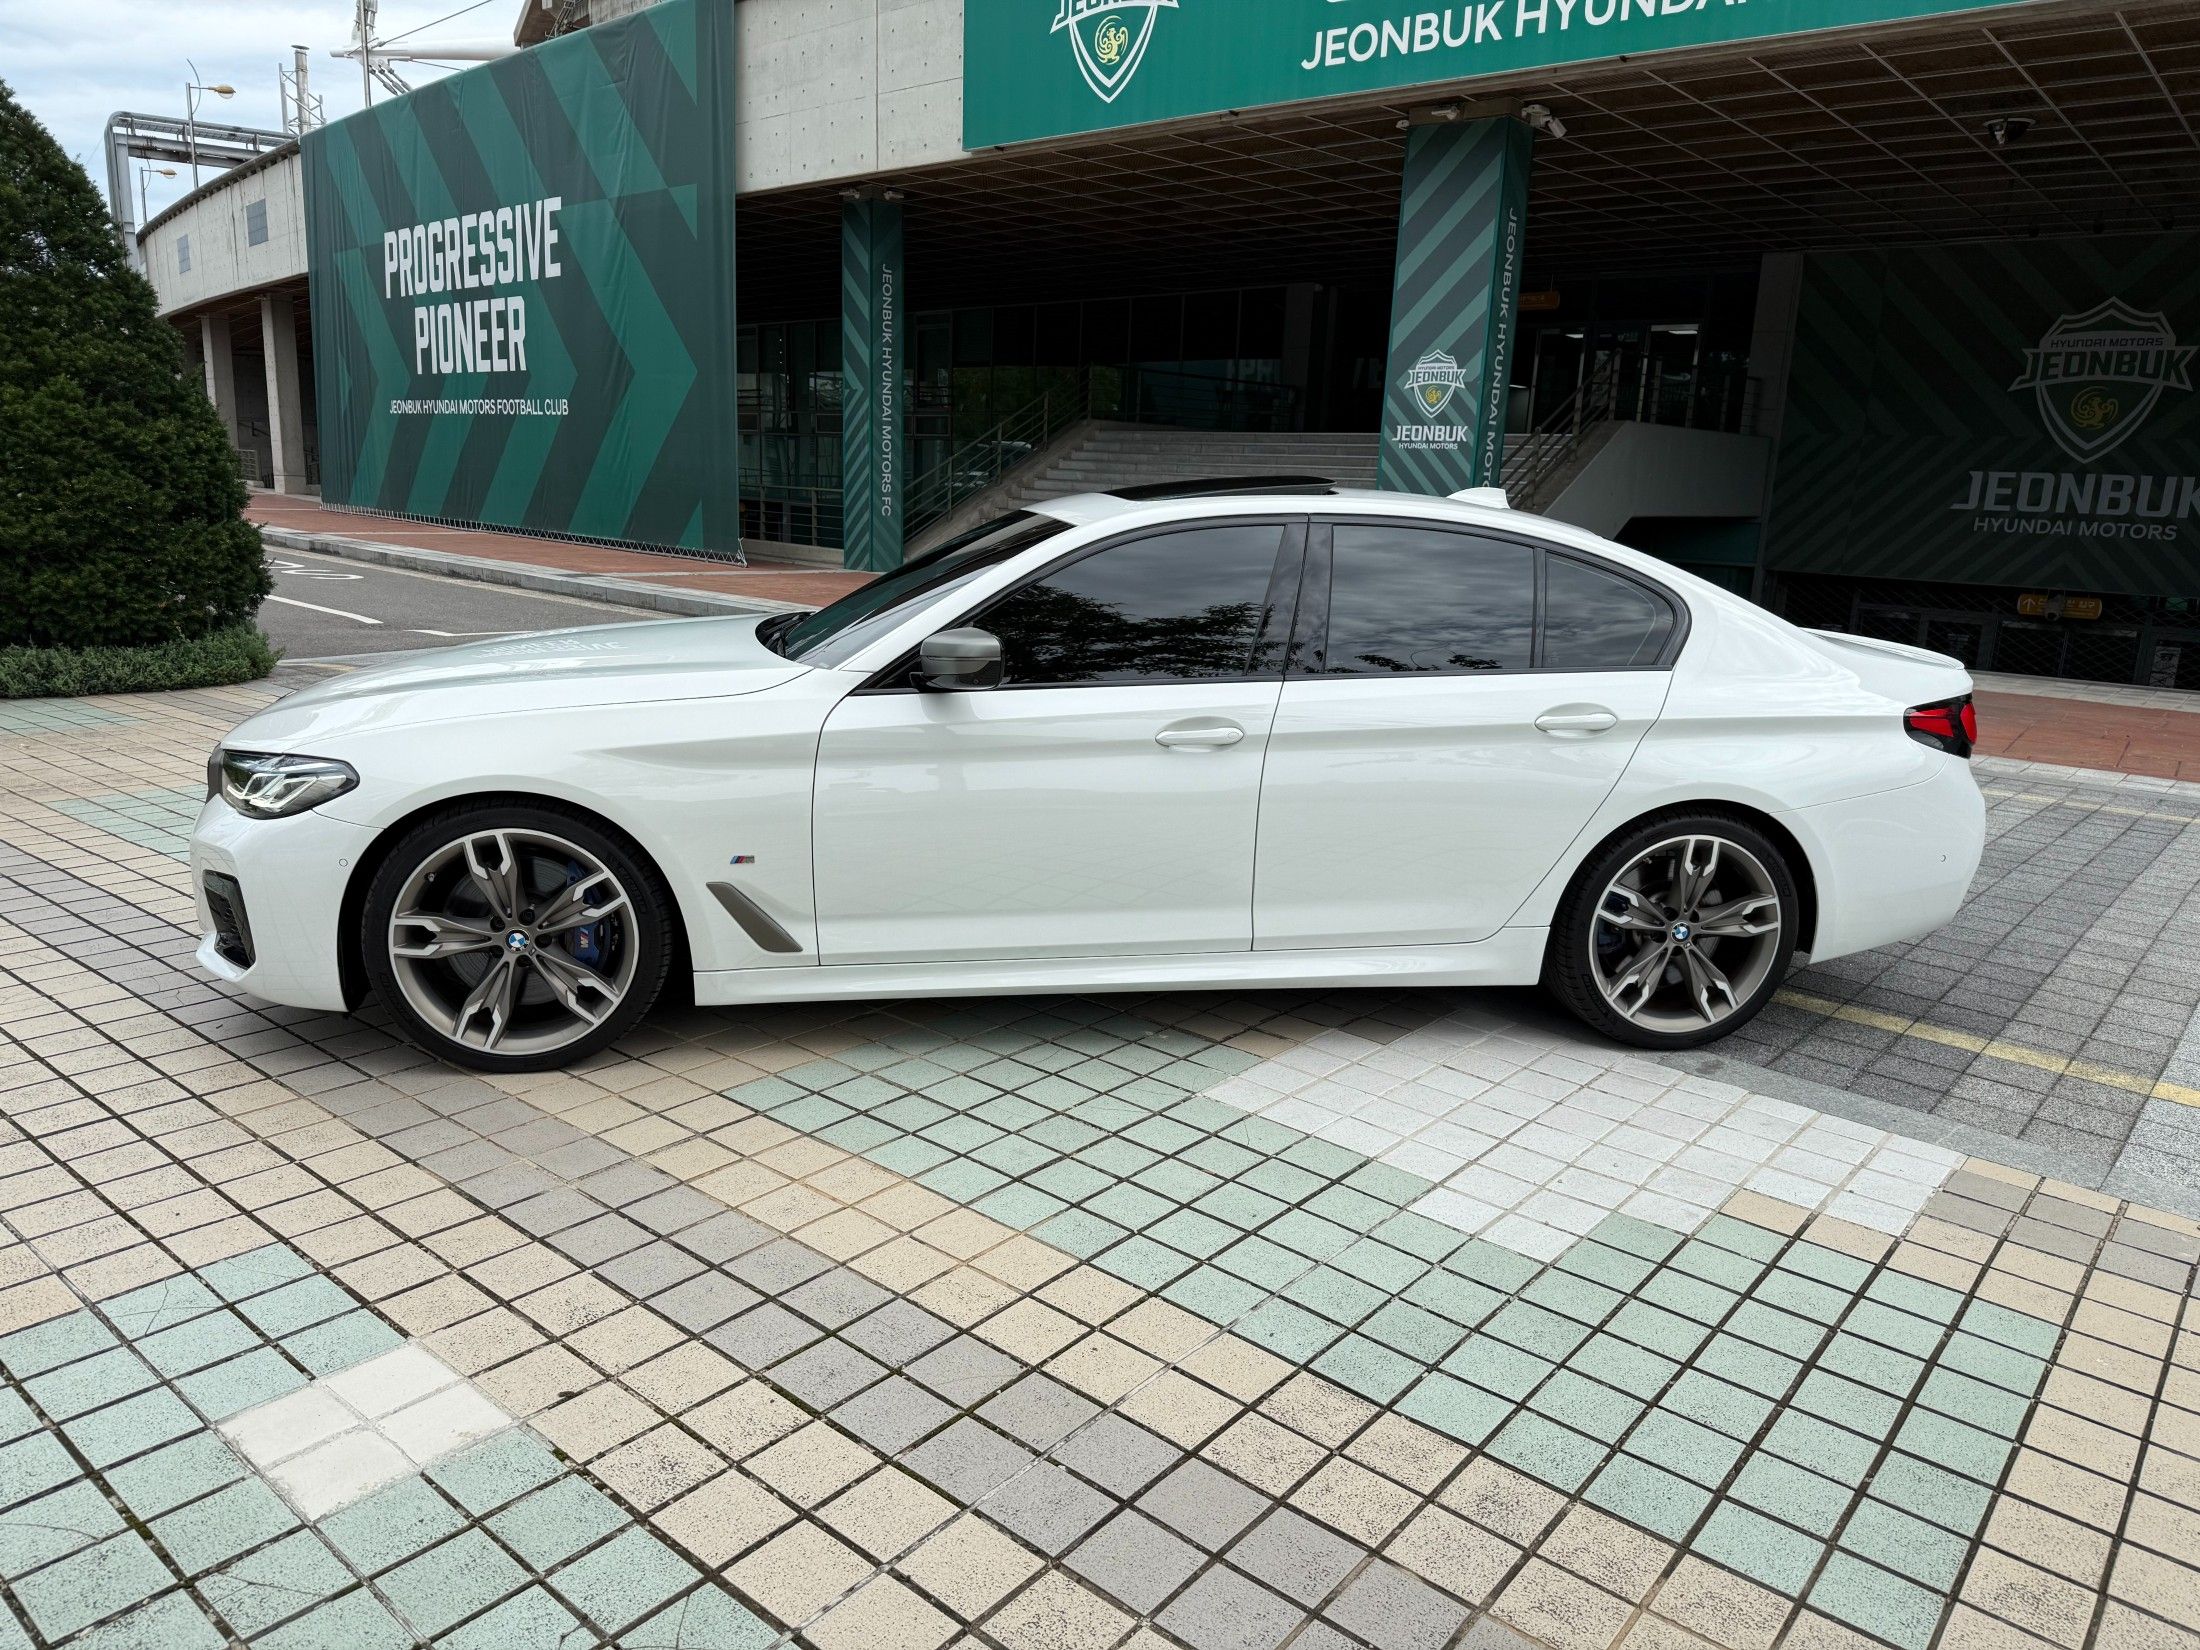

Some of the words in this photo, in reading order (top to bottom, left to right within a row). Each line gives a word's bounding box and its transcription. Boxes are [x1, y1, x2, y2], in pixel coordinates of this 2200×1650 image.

[1301, 1, 1502, 70] JEONBUK
[384, 196, 562, 299] PROGRESSIVE
[1500, 207, 1517, 319] JEONBUK
[881, 263, 893, 344] JEONBUK
[414, 296, 527, 375] PIONEER
[2050, 337, 2107, 348] HYUNDAI
[2109, 337, 2165, 347] MOTORS
[881, 348, 892, 422] HYUNDAI
[1408, 371, 1462, 384] JEONBUK
[1489, 323, 1507, 426] HYUNDAI
[2017, 350, 2186, 384] JEONBUK
[390, 399, 422, 414] JEONBUK
[423, 399, 458, 415] HYUNDAI
[459, 399, 495, 415] MOTORS
[497, 399, 543, 415] FOOTBALL
[544, 399, 569, 415] CLUB
[1391, 425, 1469, 442] JEONBUK
[1398, 442, 1429, 450] HYUNDAI
[1430, 442, 1459, 450] MOTORS
[881, 425, 892, 493] MOTORS
[881, 496, 892, 517] FC
[1949, 470, 2200, 519] JEONBUK
[1973, 517, 2073, 536] HYUNDAI
[2078, 520, 2178, 541] MOTORS
